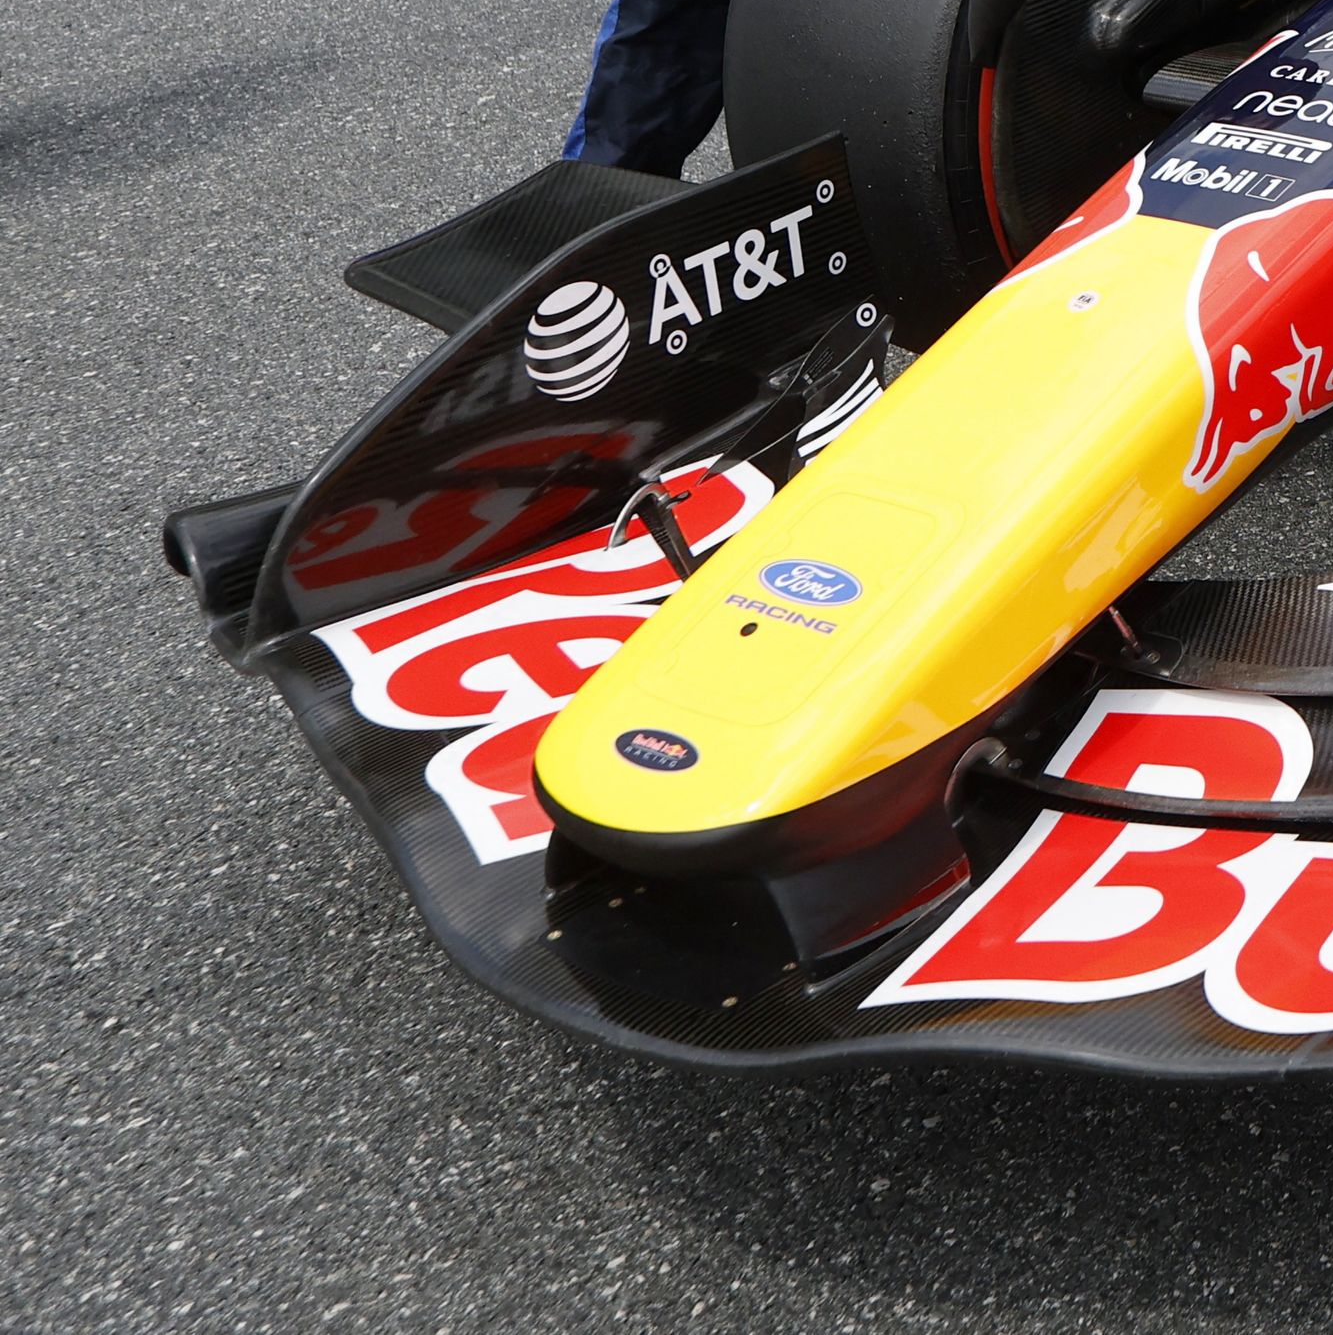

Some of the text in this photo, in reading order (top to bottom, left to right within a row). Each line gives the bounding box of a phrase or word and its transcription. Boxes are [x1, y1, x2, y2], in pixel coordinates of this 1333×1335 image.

[1190, 121, 1333, 165] PIRELLI
[1150, 156, 1247, 195] Mobil
[647, 204, 813, 347] AT&T
[773, 565, 846, 602] Ford
[724, 593, 839, 636] RACING
[623, 745, 680, 769] RACING
